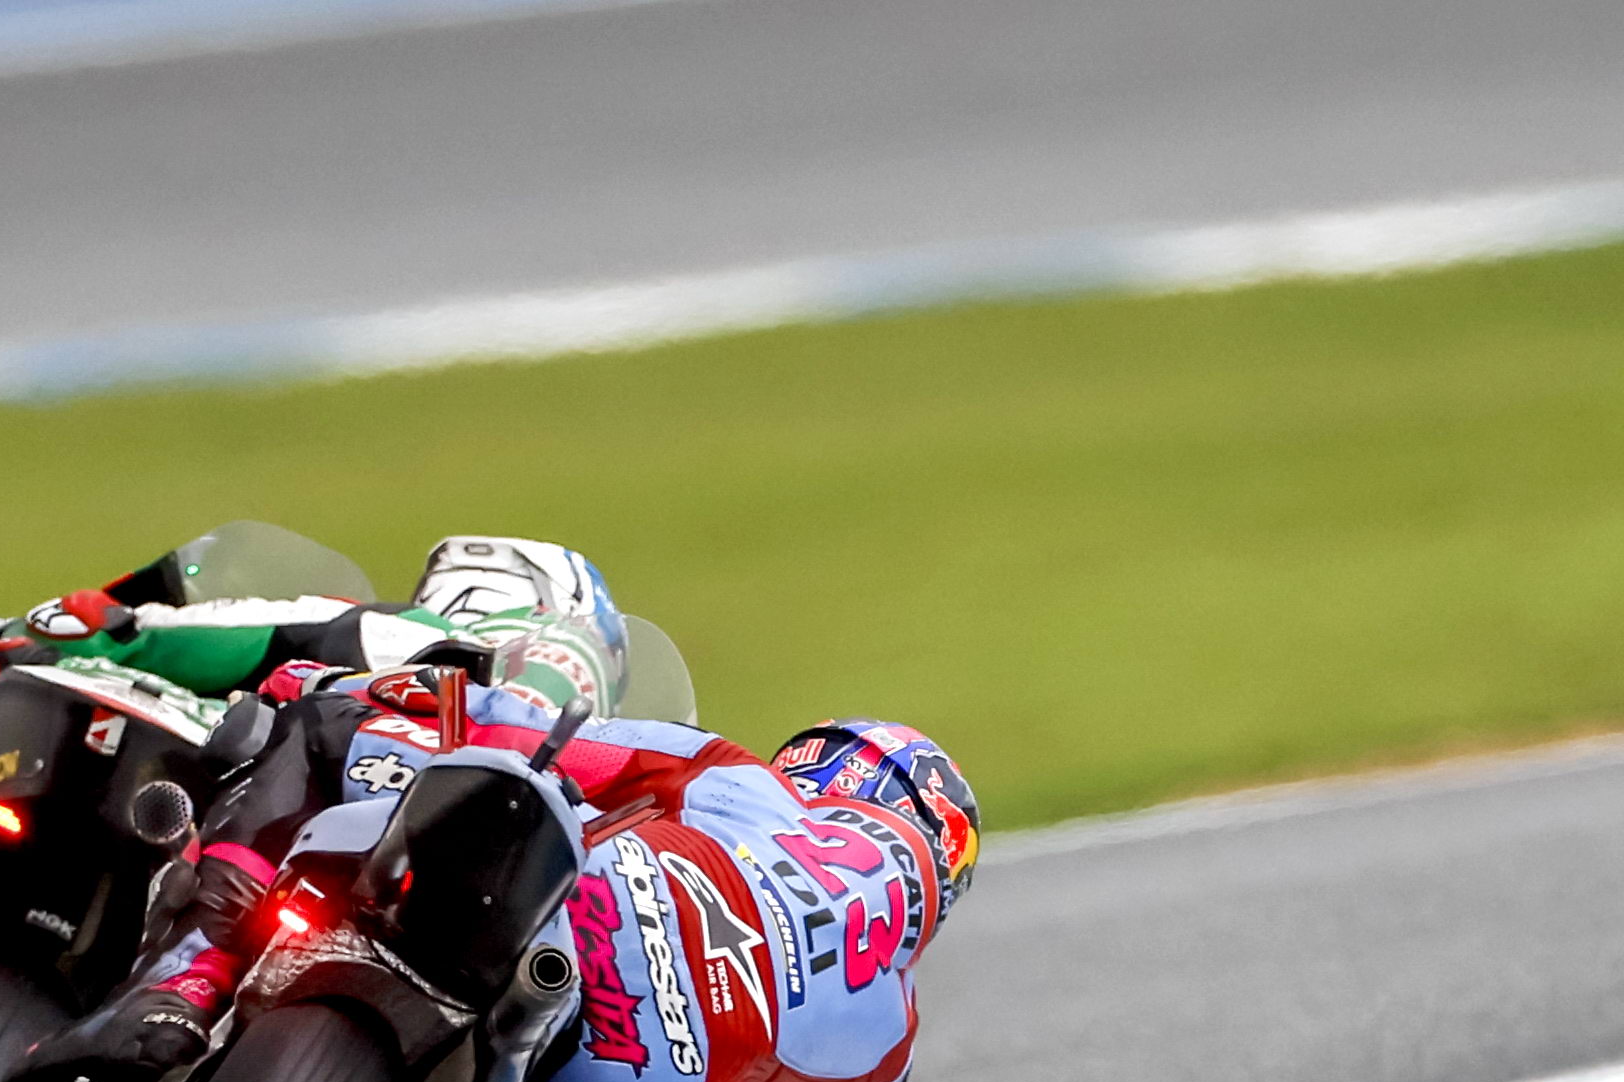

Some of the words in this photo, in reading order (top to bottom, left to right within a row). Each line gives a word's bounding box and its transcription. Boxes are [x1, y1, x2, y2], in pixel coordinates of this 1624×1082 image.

[611, 835, 705, 1076] alpinestars
[760, 888, 802, 994] MICHELIN
[769, 814, 907, 994] 23
[823, 809, 923, 950] DUCATI
